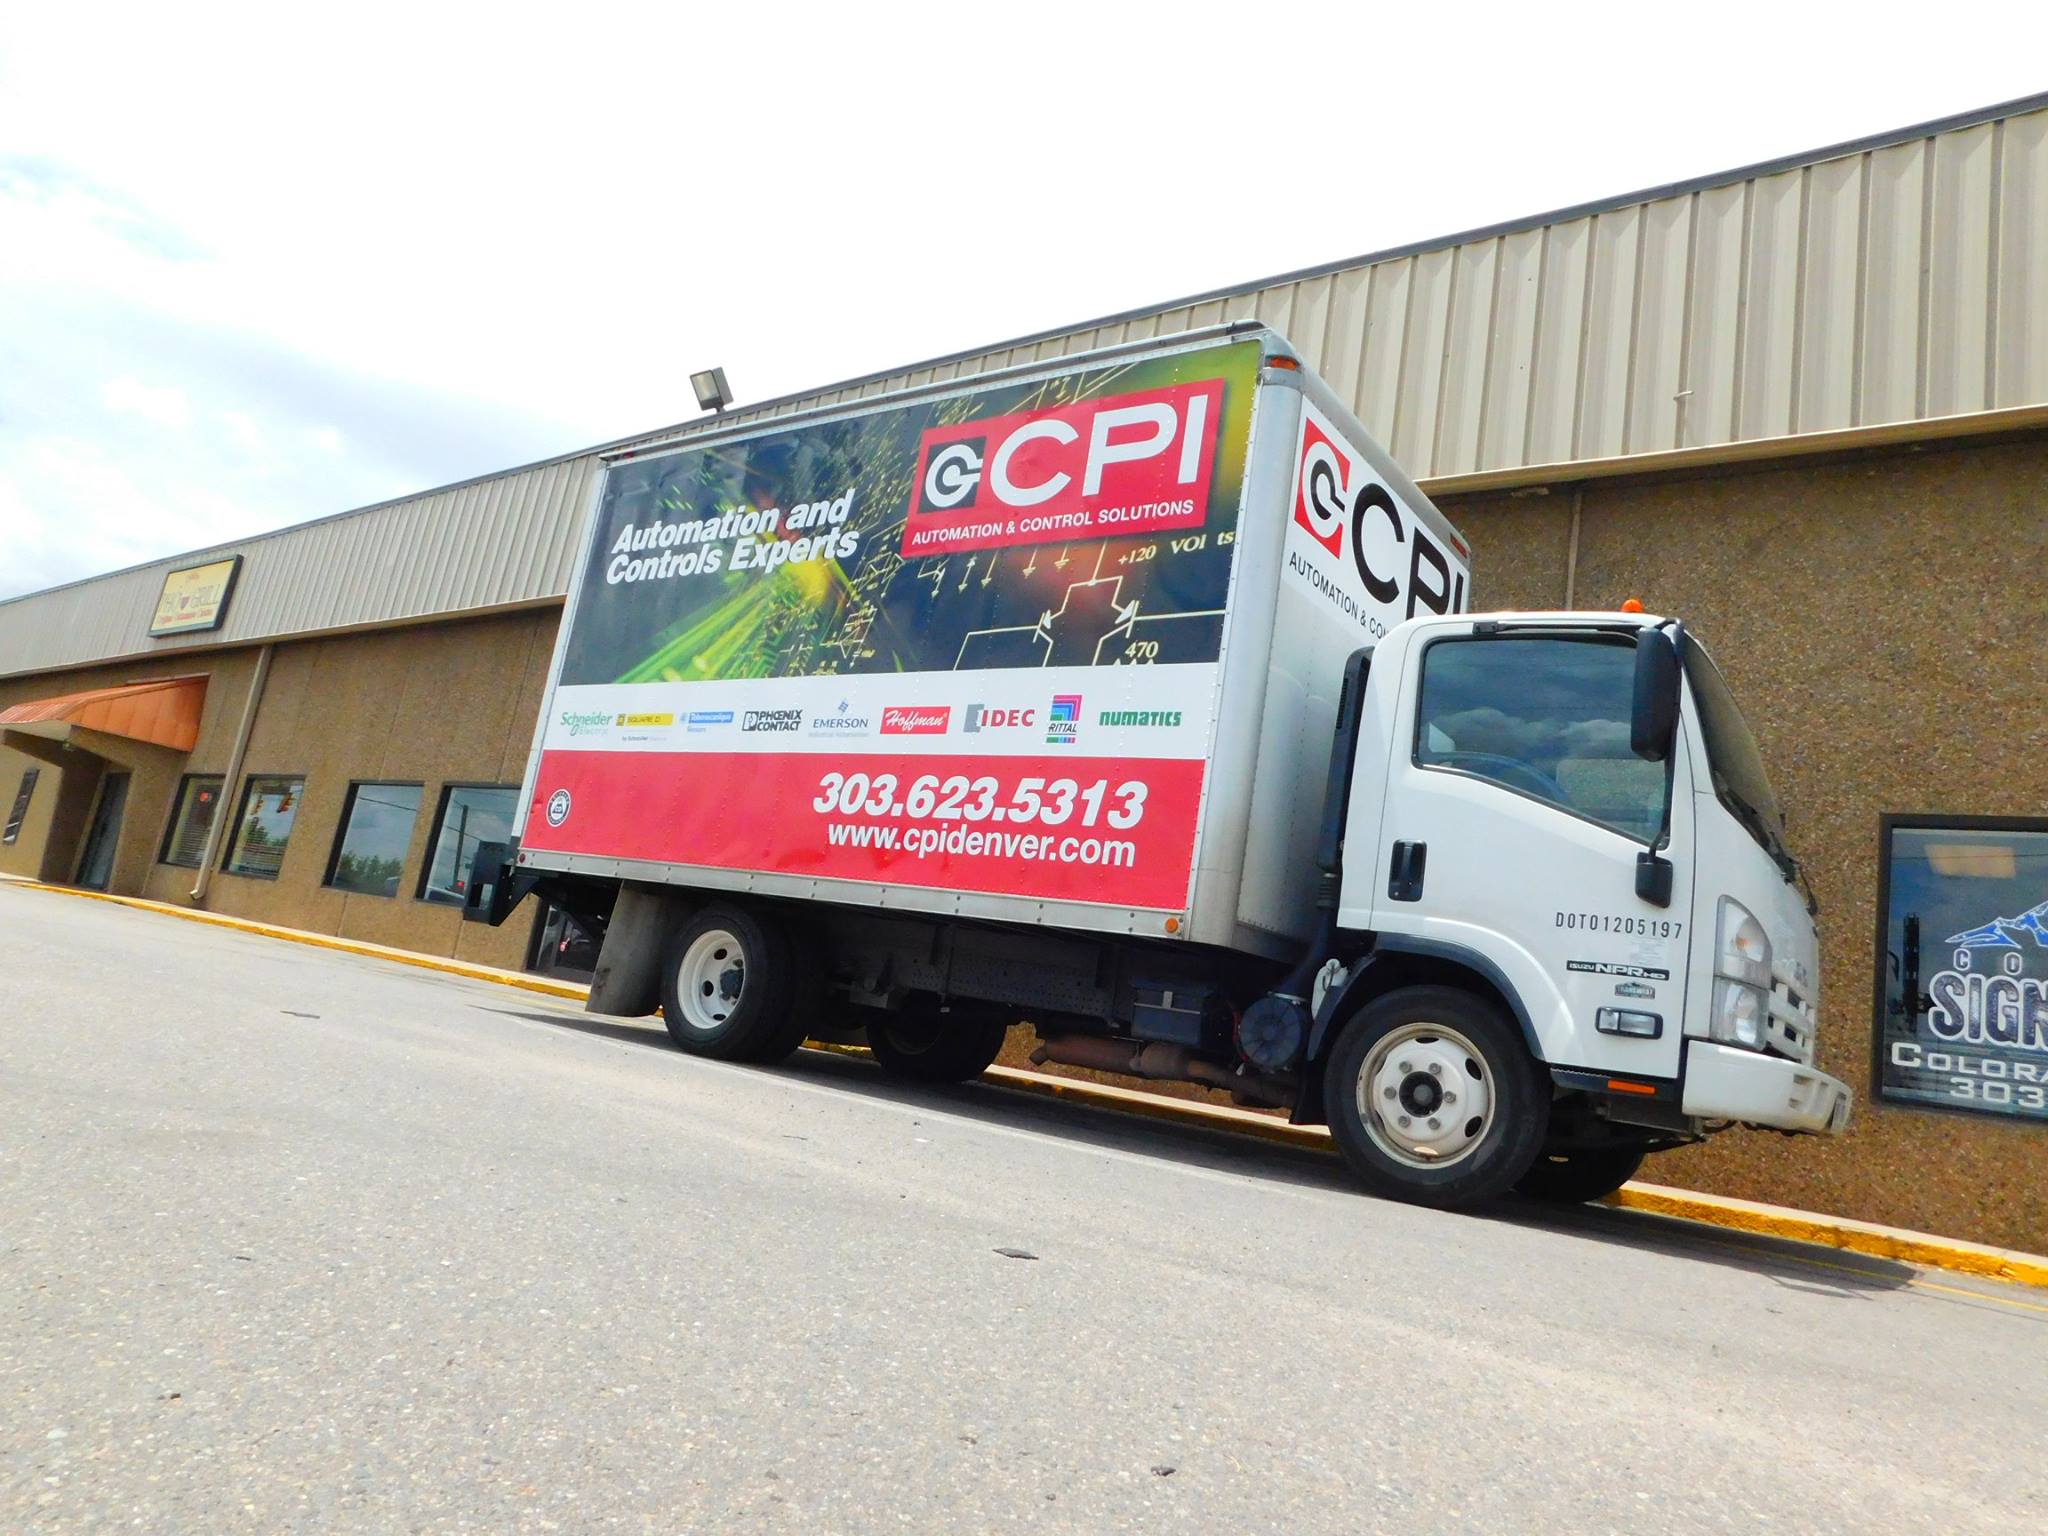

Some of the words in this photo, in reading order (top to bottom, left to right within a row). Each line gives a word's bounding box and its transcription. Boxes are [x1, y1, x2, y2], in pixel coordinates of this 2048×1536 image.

[990, 394, 1208, 507] CPI
[611, 505, 779, 553] Automation
[785, 488, 855, 529] and
[912, 522, 1002, 545] AUTOMATION
[1006, 521, 1015, 534] &
[1020, 512, 1093, 533] CONTROL
[1098, 500, 1194, 525] SOLUTIONS
[606, 543, 723, 585] Controls
[728, 528, 859, 573] Experts
[1118, 545, 1157, 565] +120
[1290, 552, 1358, 619] AUTOMATION
[1360, 610, 1366, 627] &
[1125, 641, 1159, 658] 470
[560, 711, 612, 726] Schneider
[757, 721, 800, 731] CONTACT
[813, 718, 869, 728] EMERSON
[885, 709, 944, 731] Hoffman
[981, 709, 1035, 727] IDEC
[1048, 723, 1077, 733] RITTAL
[813, 772, 1148, 829] 303.623.5313
[828, 823, 1136, 867] www.cpidenver.com
[1950, 1077, 2045, 1109] 303
